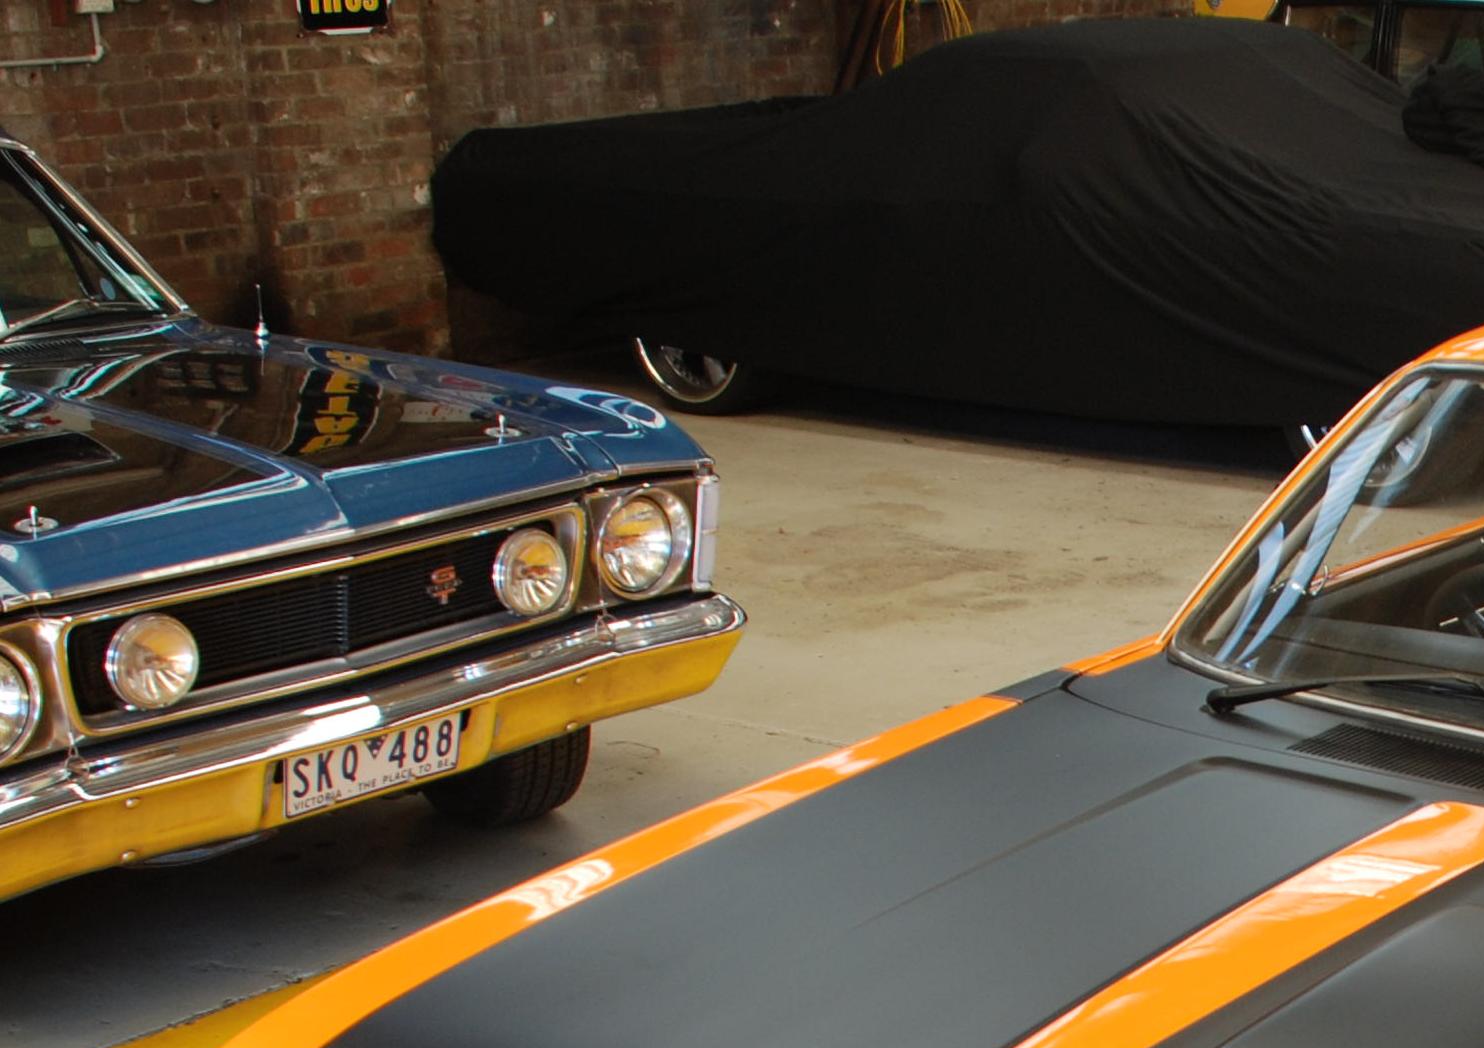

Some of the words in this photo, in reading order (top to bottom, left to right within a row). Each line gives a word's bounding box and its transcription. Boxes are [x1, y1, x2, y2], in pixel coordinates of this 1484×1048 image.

[293, 744, 359, 799] SKQ
[389, 719, 453, 768] 488
[293, 790, 343, 811] VICTORIA
[358, 778, 376, 793] THE
[418, 763, 431, 774] TO
